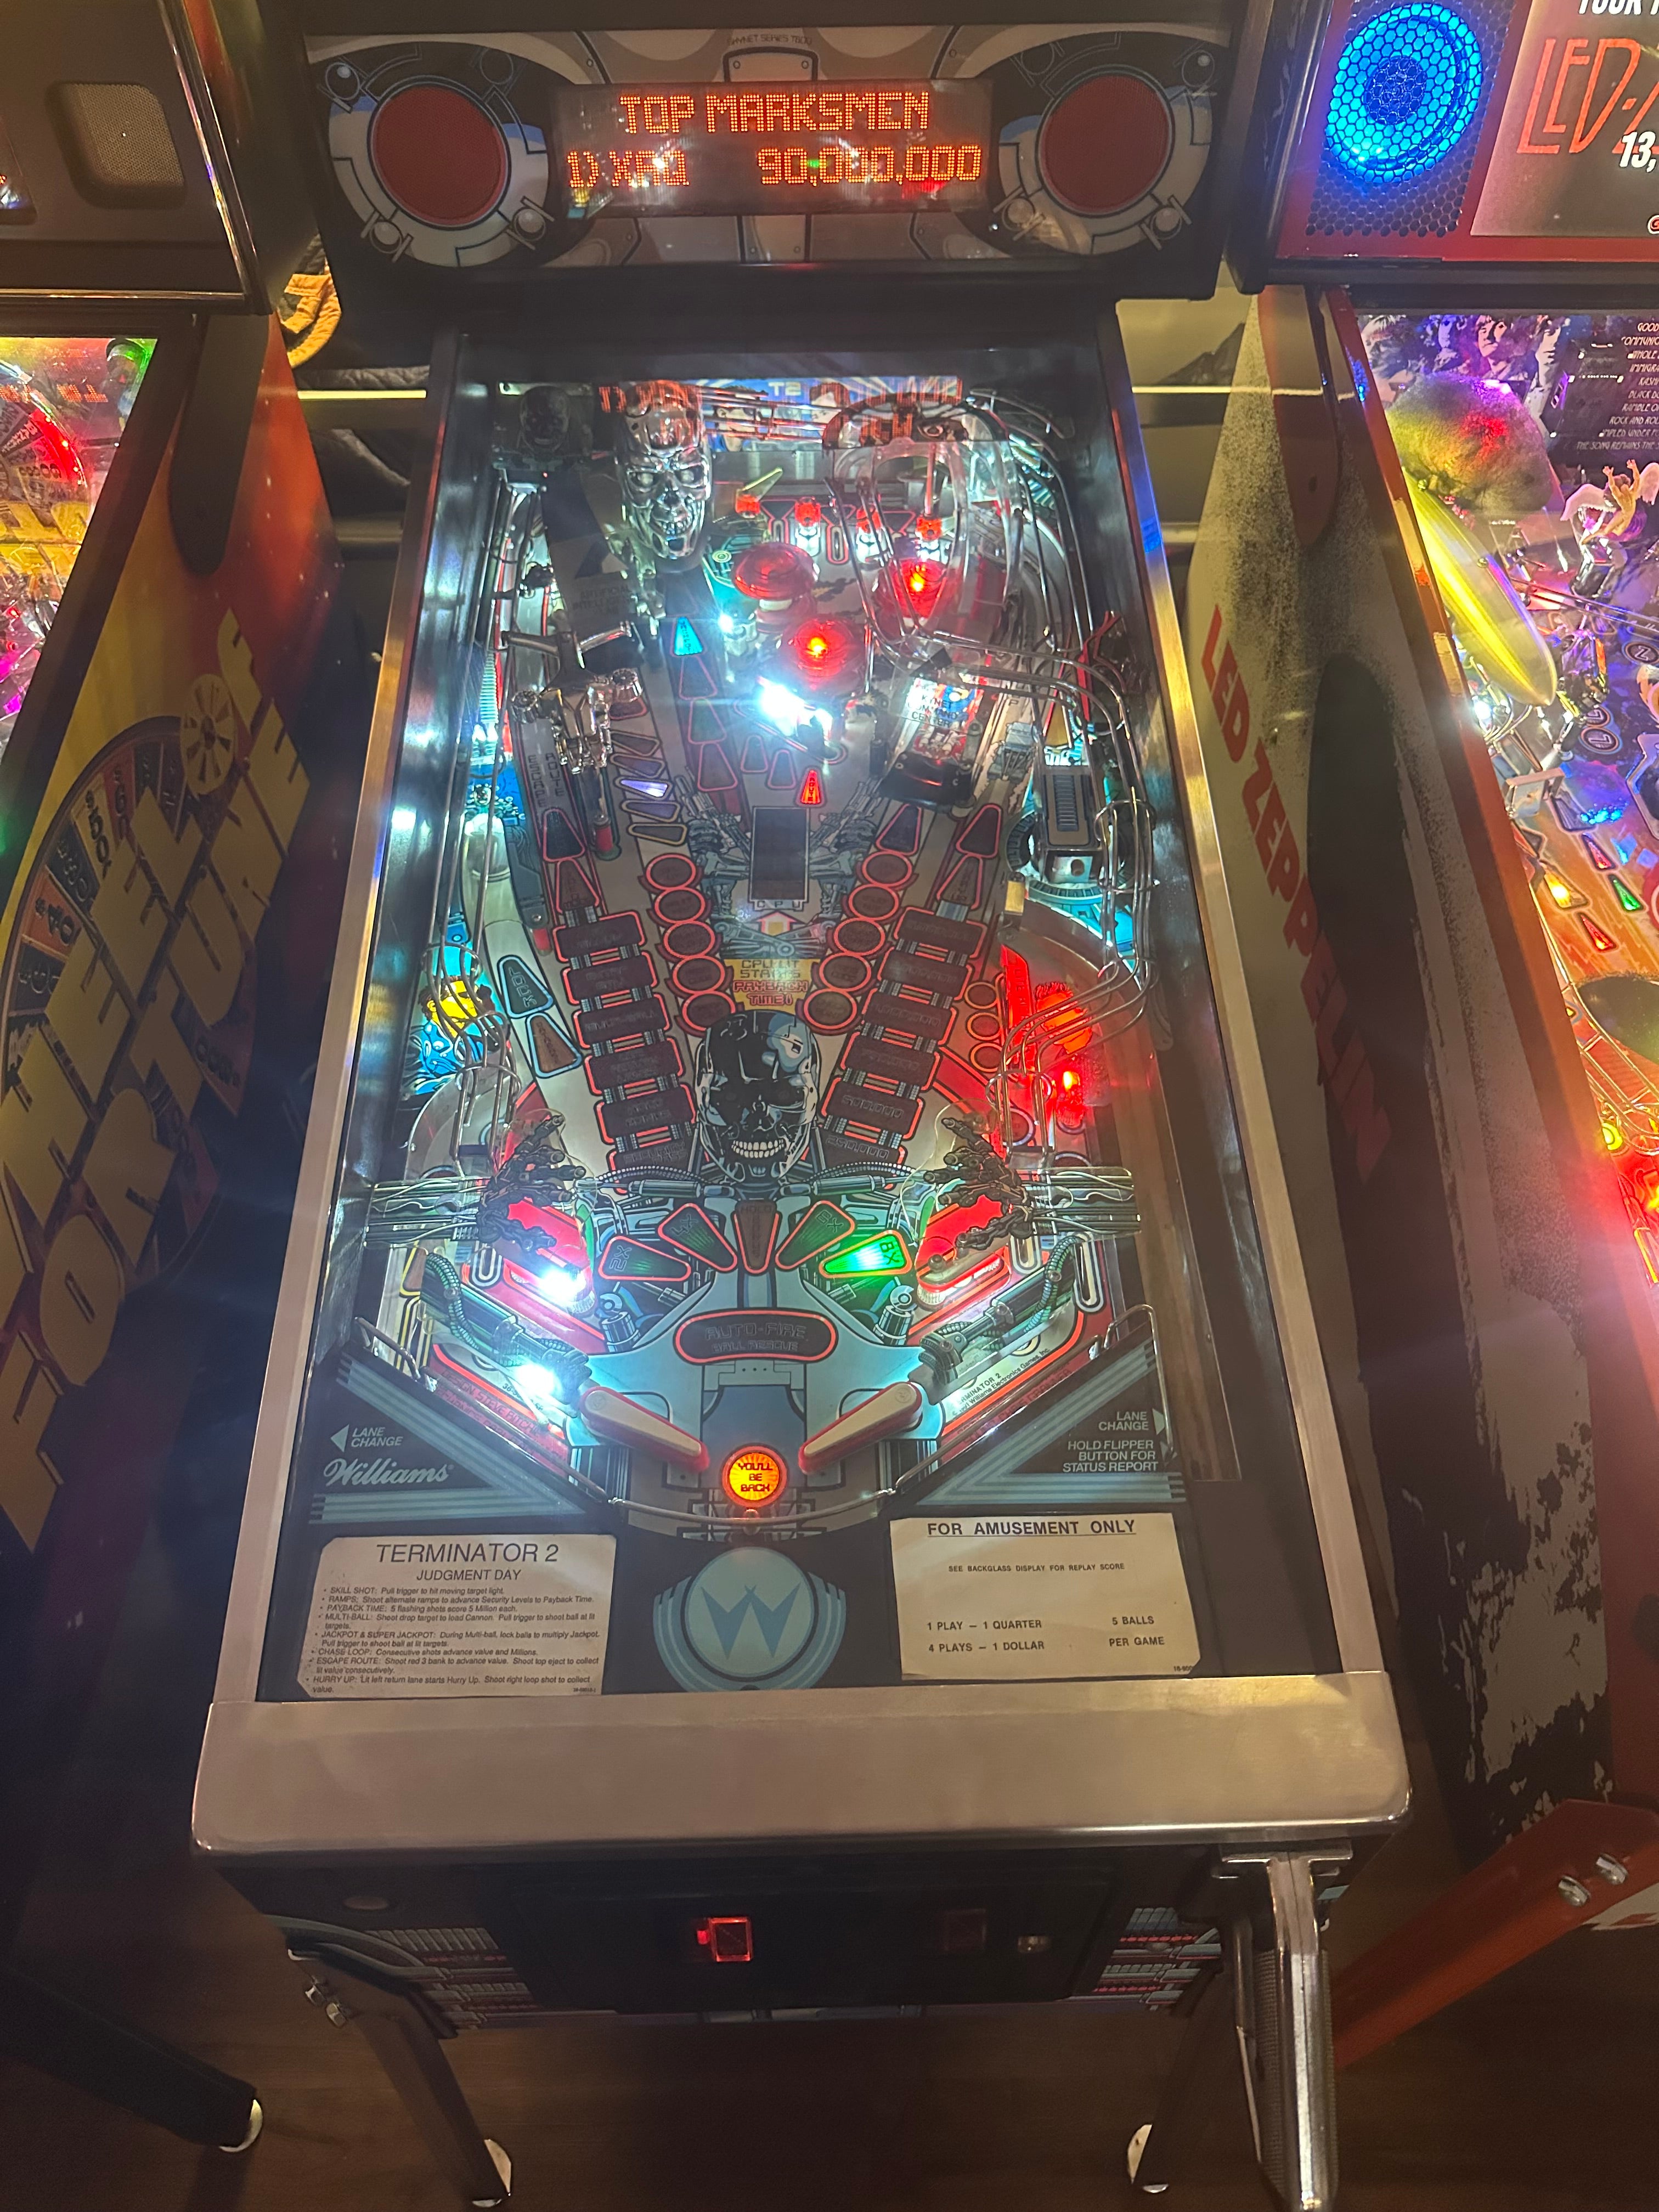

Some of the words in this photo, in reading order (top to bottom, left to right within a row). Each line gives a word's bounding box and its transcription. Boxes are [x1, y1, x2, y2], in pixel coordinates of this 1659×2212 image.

[619, 95, 695, 134] TOP
[706, 91, 929, 133] MARKSMEN
[567, 151, 599, 188] 1)
[609, 149, 690, 187] XAQ
[757, 145, 983, 187] 90,000,000
[1201, 605, 1249, 763] LED
[1242, 736, 1392, 1186] ZEPPELIN
[732, 980, 808, 992] PAYBACK
[747, 993, 794, 1006] TIME!
[476, 1391, 506, 1415] STEVE
[1116, 1411, 1148, 1421] LANE
[352, 1426, 385, 1437] LANE
[1098, 1421, 1149, 1431] CHANGE
[350, 1436, 403, 1448] CHANGE
[1068, 1440, 1101, 1450] HOLD
[1103, 1440, 1154, 1449] FLIPPER
[1079, 1451, 1128, 1462] BUTTON
[1130, 1451, 1156, 1460] FOR
[323, 1457, 449, 1487] Williams
[1062, 1462, 1107, 1472] STATUS
[1107, 1462, 1159, 1472] REPORT
[741, 1483, 770, 1492] BACK
[928, 1523, 962, 1536] FOR
[974, 1521, 1079, 1536] AMUSEMENT
[1090, 1520, 1136, 1534] ONLY
[376, 1543, 539, 1562] TERMINATOR
[545, 1543, 559, 1562] 2
[416, 1570, 491, 1581] JUDGMENT
[494, 1570, 522, 1581] DAY
[544, 1596, 573, 1604] Payback
[937, 1622, 963, 1630] PLAY
[983, 1621, 988, 1629] 1
[992, 1620, 1042, 1629] QUARTER
[1122, 1617, 1154, 1625] BALLS
[928, 1644, 934, 1652] 4
[939, 1643, 973, 1652] PLAYS
[1003, 1641, 1045, 1651] DOLLAR
[1109, 1638, 1129, 1647] PER
[1134, 1637, 1165, 1646] GAME
